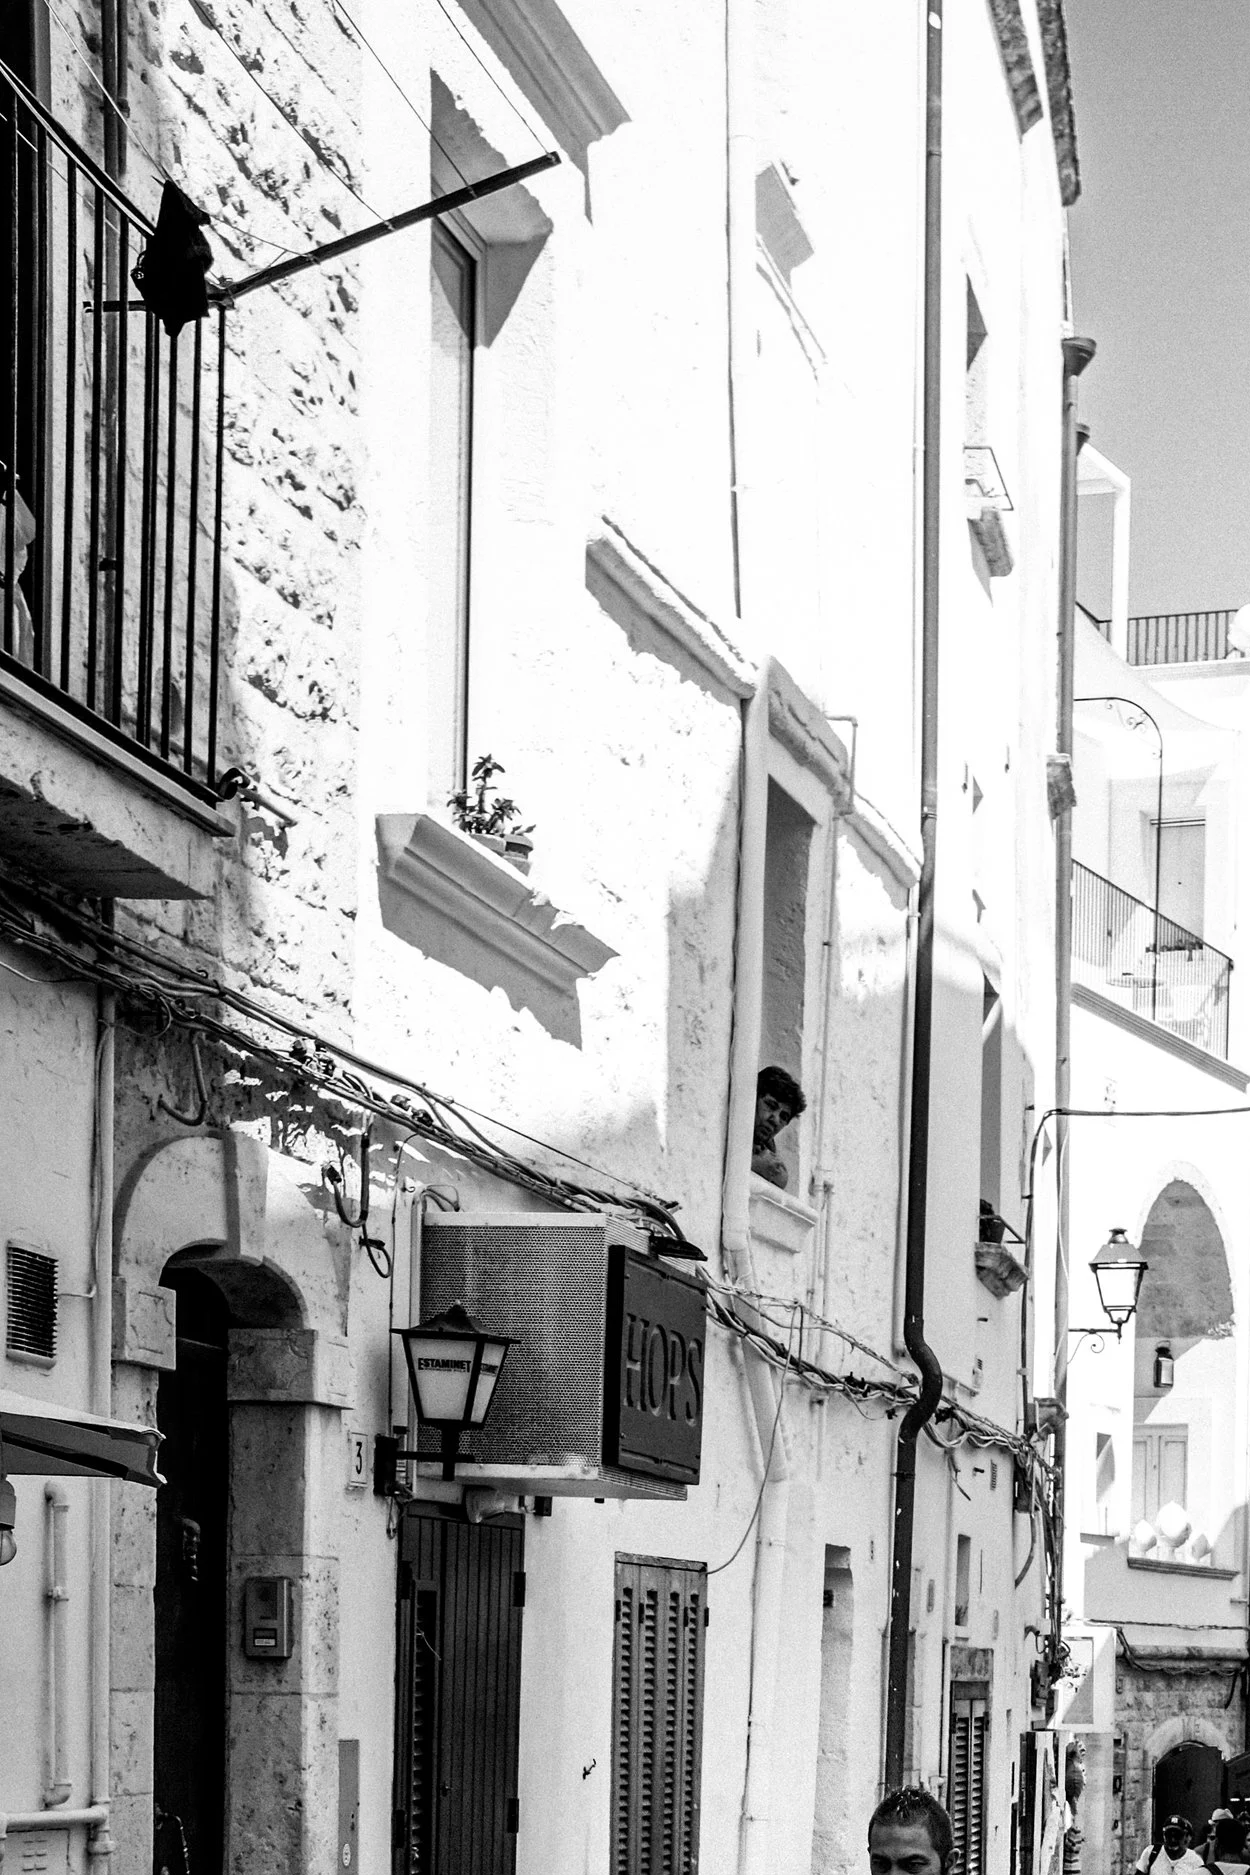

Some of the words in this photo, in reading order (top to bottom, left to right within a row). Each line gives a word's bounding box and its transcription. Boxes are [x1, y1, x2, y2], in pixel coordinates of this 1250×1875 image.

[418, 1357, 472, 1373] ESTAMINET
[623, 1312, 702, 1428] HOPS
[355, 1441, 363, 1475] 3
